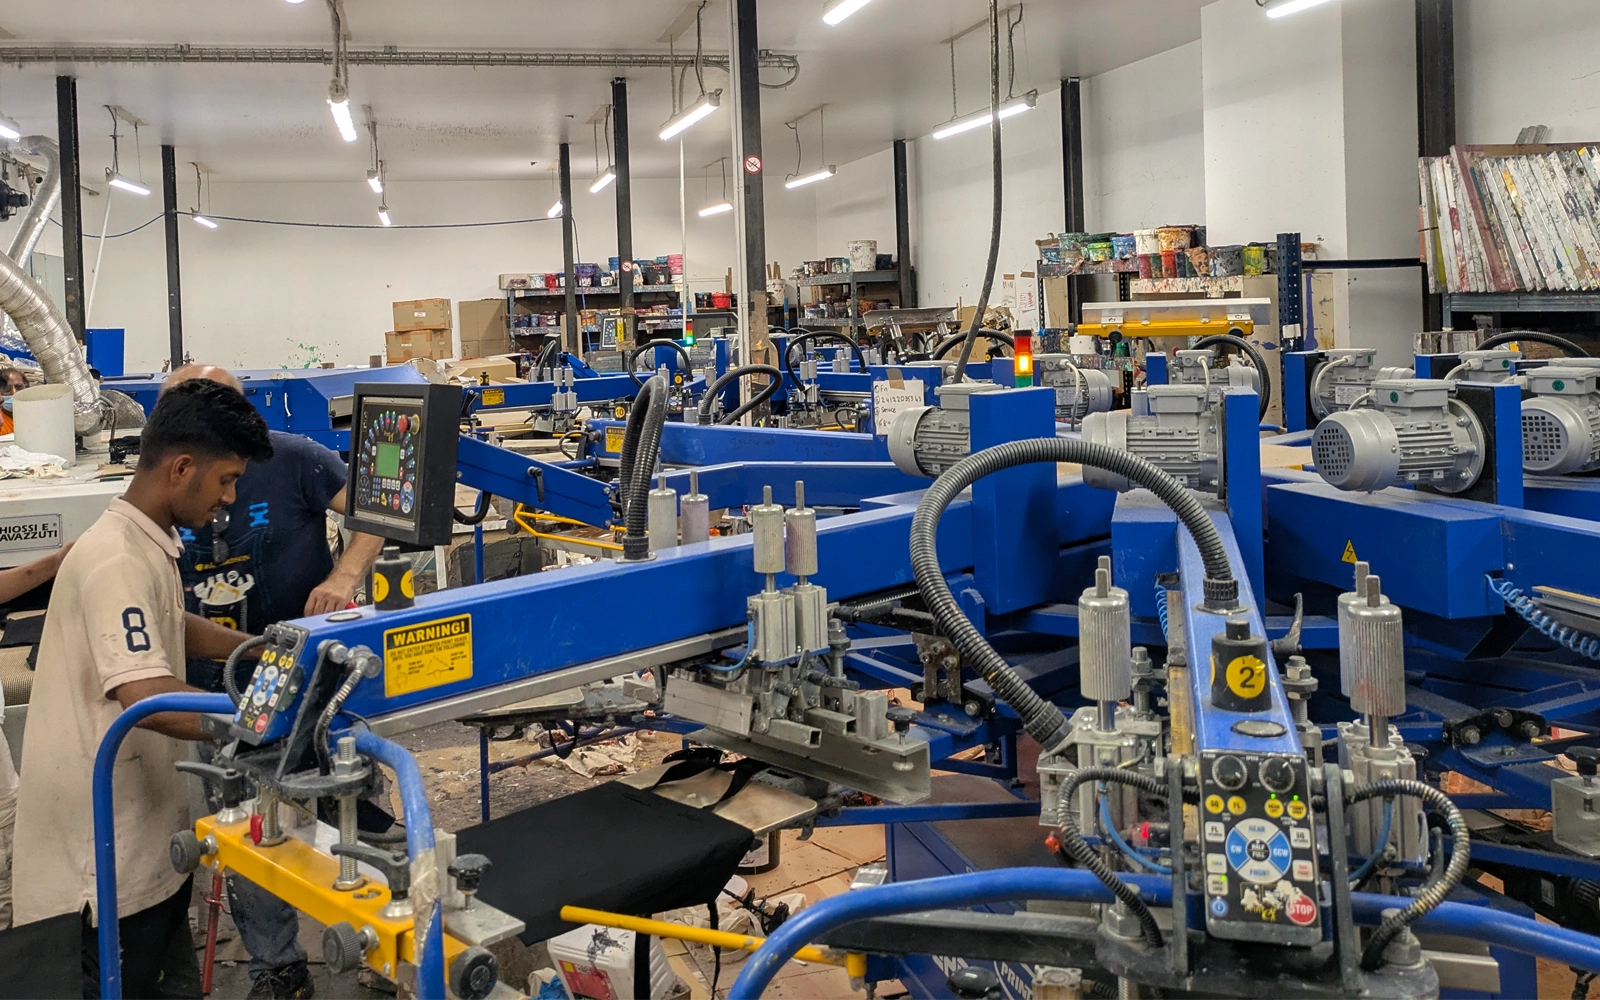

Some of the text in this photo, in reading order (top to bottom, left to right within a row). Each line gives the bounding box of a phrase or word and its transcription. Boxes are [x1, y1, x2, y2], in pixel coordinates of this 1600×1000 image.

[616, 407, 624, 415] 10
[122, 606, 151, 652] 8
[393, 621, 465, 646] WARNING!
[1240, 666, 1255, 688] 2
[1231, 845, 1242, 853] CW
[1273, 848, 1288, 857] CCW
[1249, 868, 1270, 876] FRONT
[1289, 904, 1313, 914] STOP
